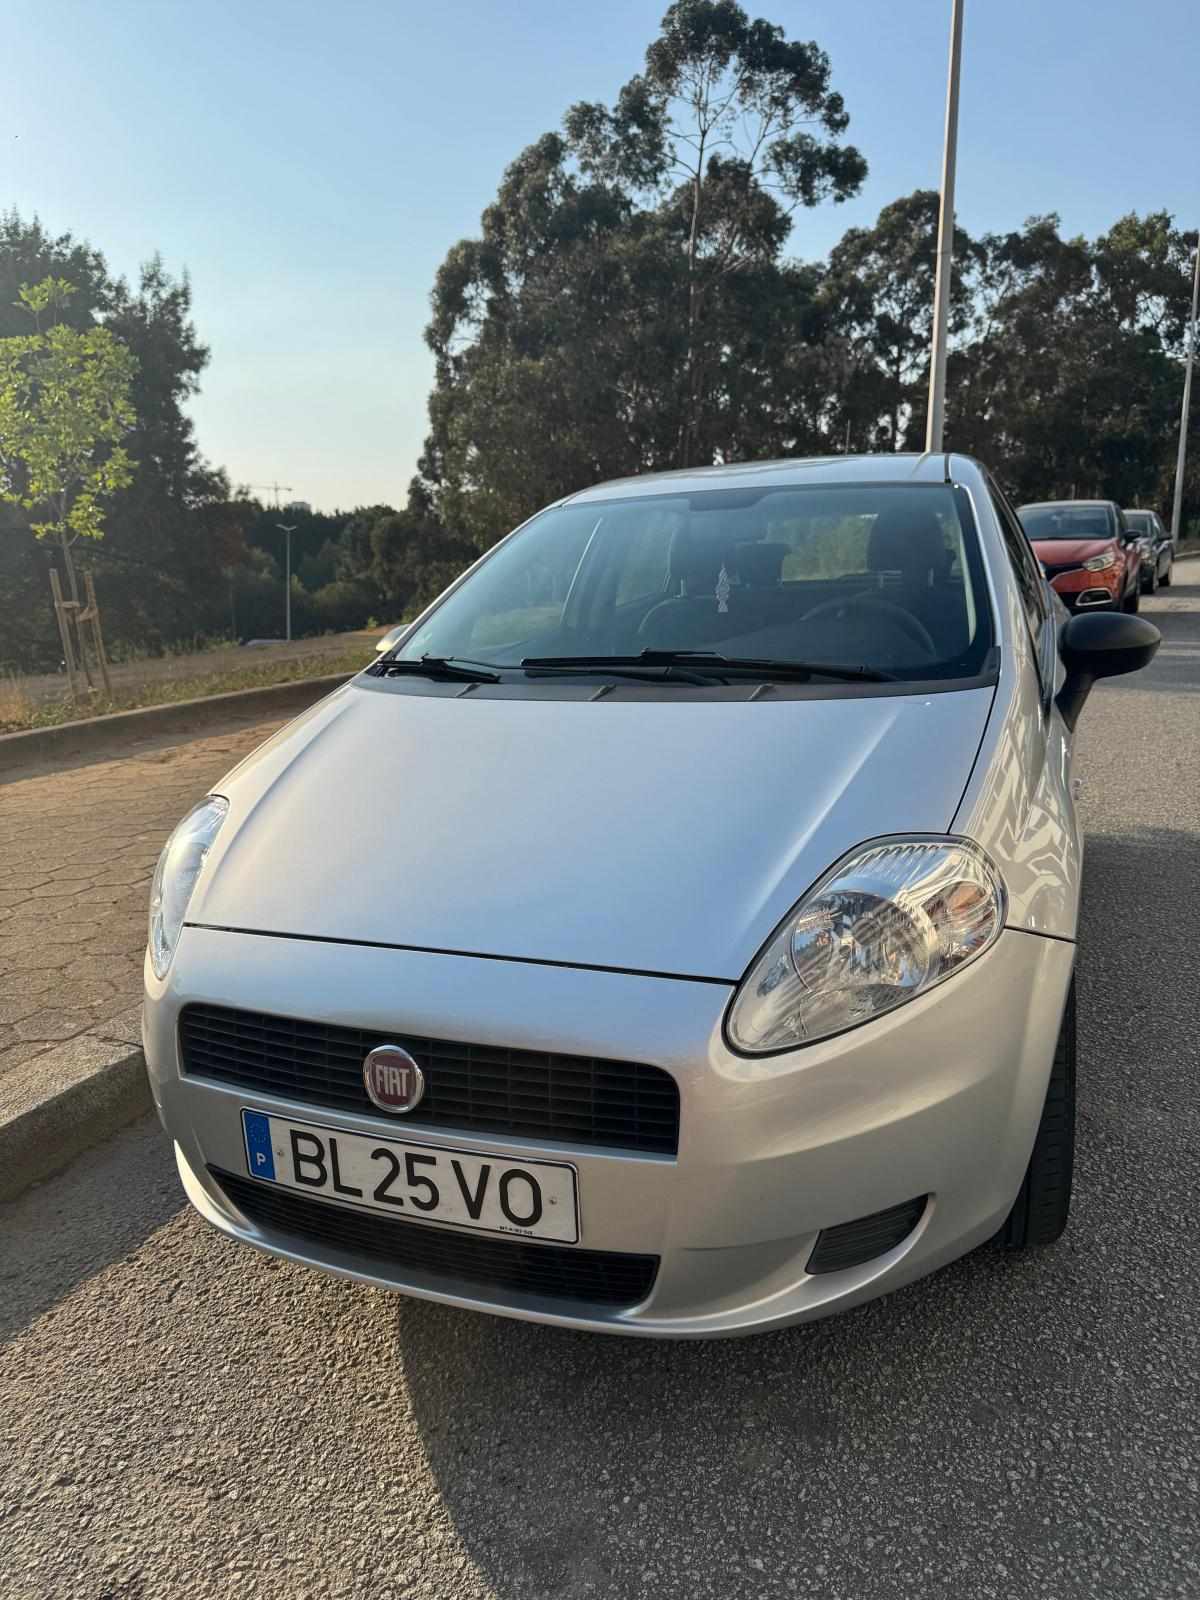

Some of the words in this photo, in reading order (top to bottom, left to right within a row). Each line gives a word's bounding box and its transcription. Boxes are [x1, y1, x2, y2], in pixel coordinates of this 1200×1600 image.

[375, 1064, 411, 1097] FIAT
[256, 1152, 266, 1166] P
[289, 1129, 363, 1197] BL
[370, 1148, 440, 1211] 25
[450, 1160, 543, 1227] VO
